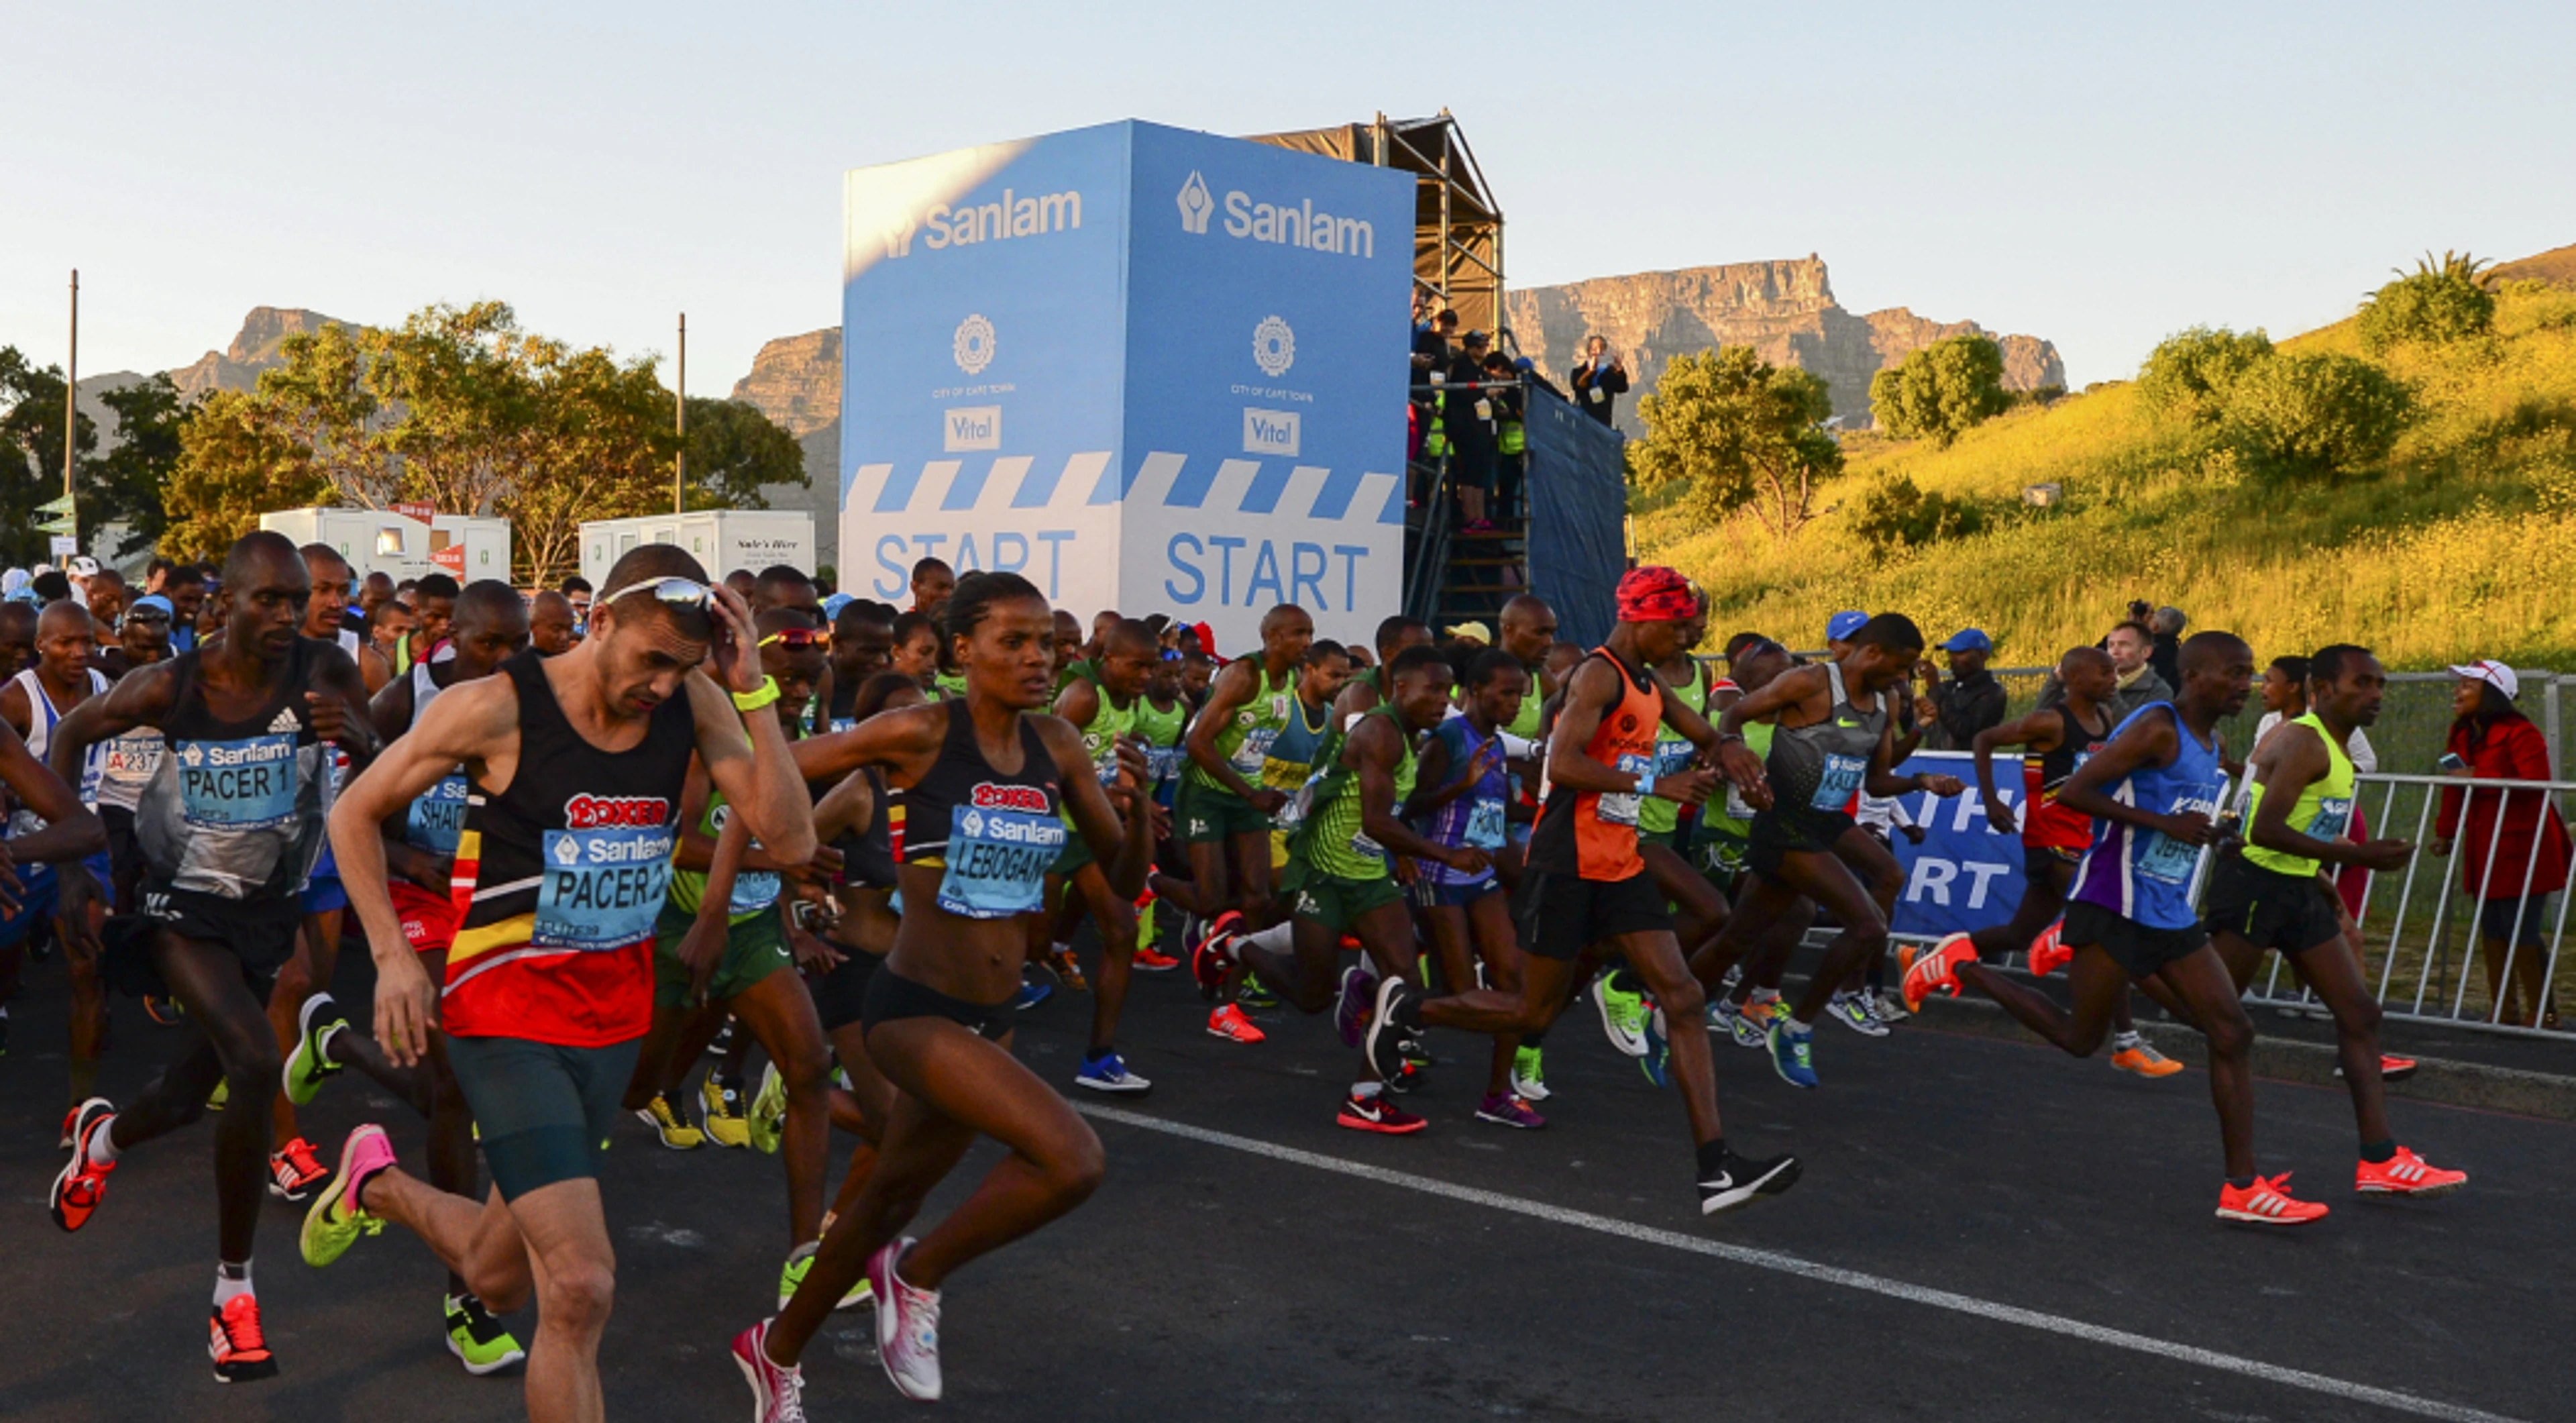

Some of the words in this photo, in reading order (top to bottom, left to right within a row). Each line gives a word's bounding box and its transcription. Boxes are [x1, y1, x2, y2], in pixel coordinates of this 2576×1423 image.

[925, 189, 1081, 249] Sanlam
[1224, 191, 1373, 259] Sanlam
[952, 415, 992, 440] Vital
[1251, 416, 1291, 445] Vital
[1165, 532, 1369, 612] START
[209, 742, 290, 766] Sanlam
[185, 766, 271, 800] PACER
[278, 763, 287, 791] 1
[971, 780, 1051, 814] BOXER
[564, 793, 669, 829] BOXER
[988, 816, 1063, 845] Sanlam
[588, 835, 671, 863] Sanlam
[553, 865, 648, 910] PACER
